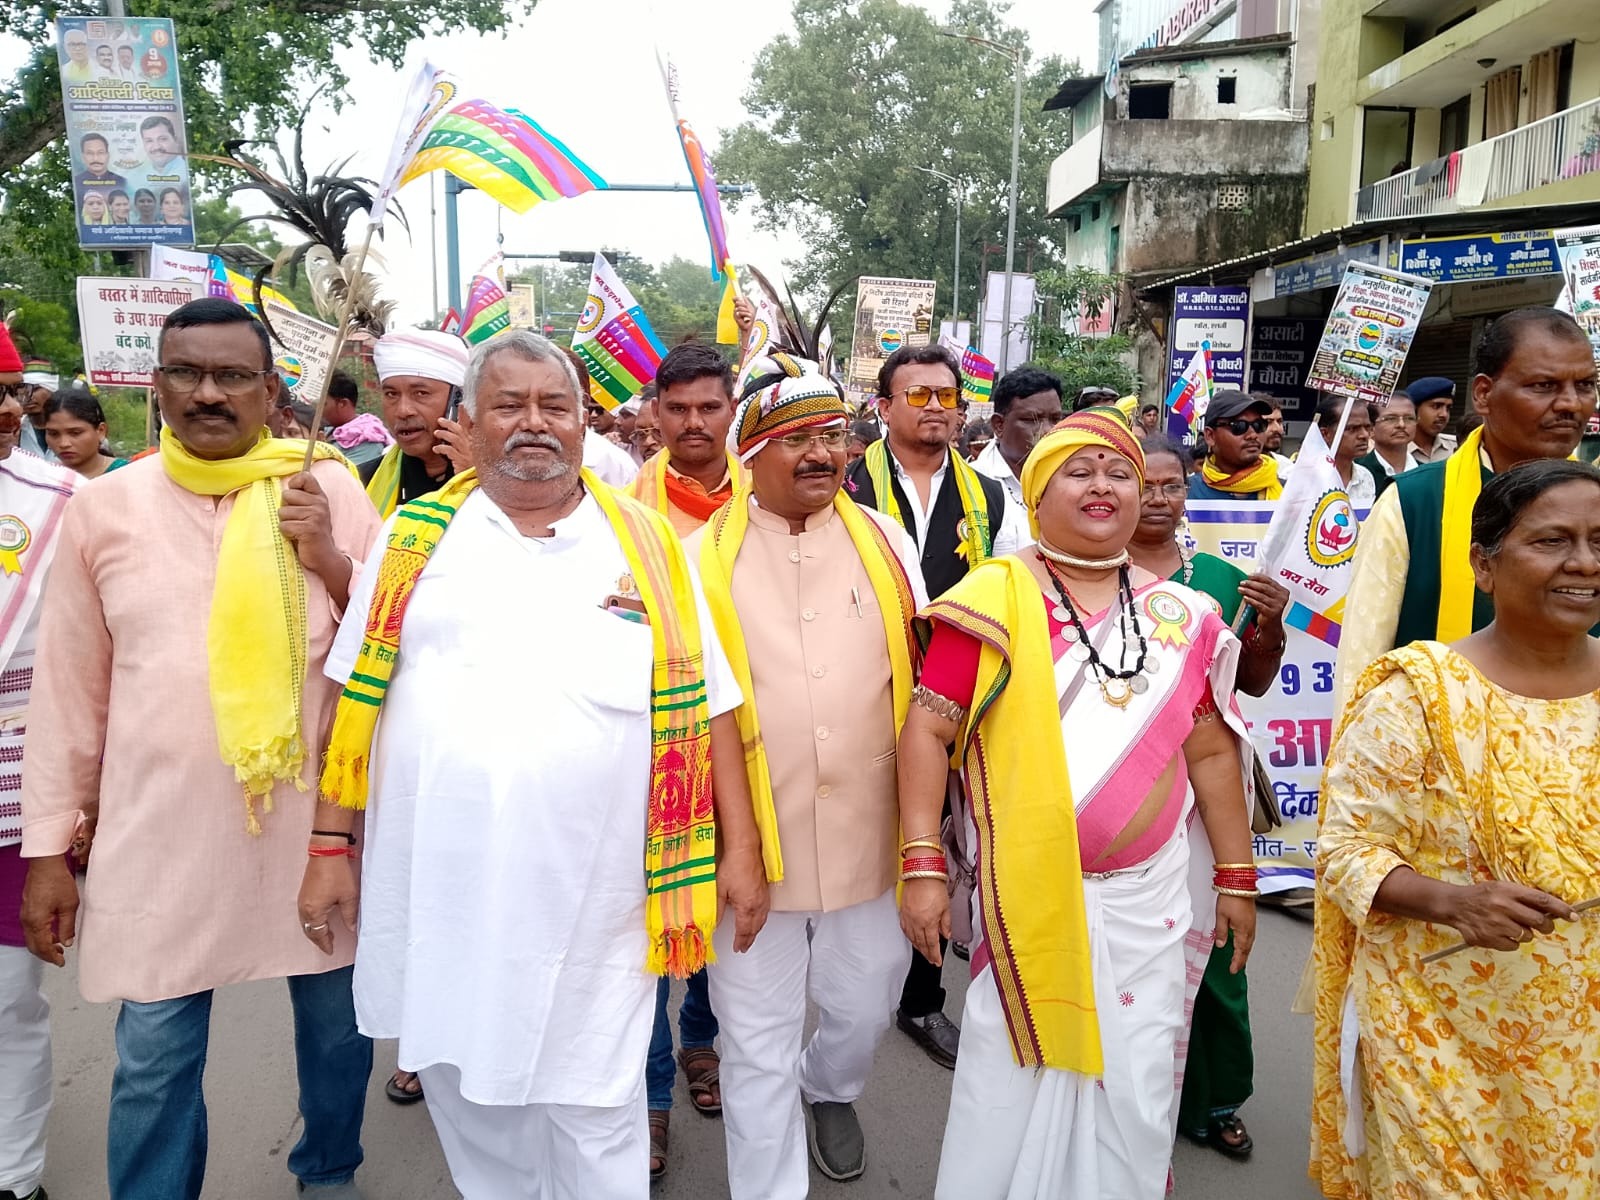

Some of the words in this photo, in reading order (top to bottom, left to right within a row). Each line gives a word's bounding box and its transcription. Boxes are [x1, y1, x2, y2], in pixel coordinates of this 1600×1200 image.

[149, 47, 158, 60] 9
[68, 81, 134, 101] आदिवासी
[136, 82, 175, 101] दिवस
[98, 288, 128, 302] बस्तर
[129, 284, 139, 302] में
[142, 287, 192, 305] आदिवासियों
[1361, 279, 1391, 291] अनुसूचित
[1177, 291, 1189, 303] डॉ.
[1191, 291, 1217, 304] अमित
[1219, 291, 1248, 304] असाटी
[112, 307, 125, 325] के
[128, 312, 147, 326] उपर
[115, 330, 132, 348] बंद
[134, 331, 155, 352] करो,
[1259, 322, 1304, 342] असाटी
[1172, 357, 1185, 369] डॉ.
[1258, 365, 1299, 385] चौधरी
[1220, 541, 1258, 558] जय
[1279, 568, 1304, 585] जय
[1303, 578, 1330, 597] सेवा
[1281, 663, 1300, 696] 9
[1267, 718, 1333, 768] आ
[695, 826, 713, 841] सेवा
